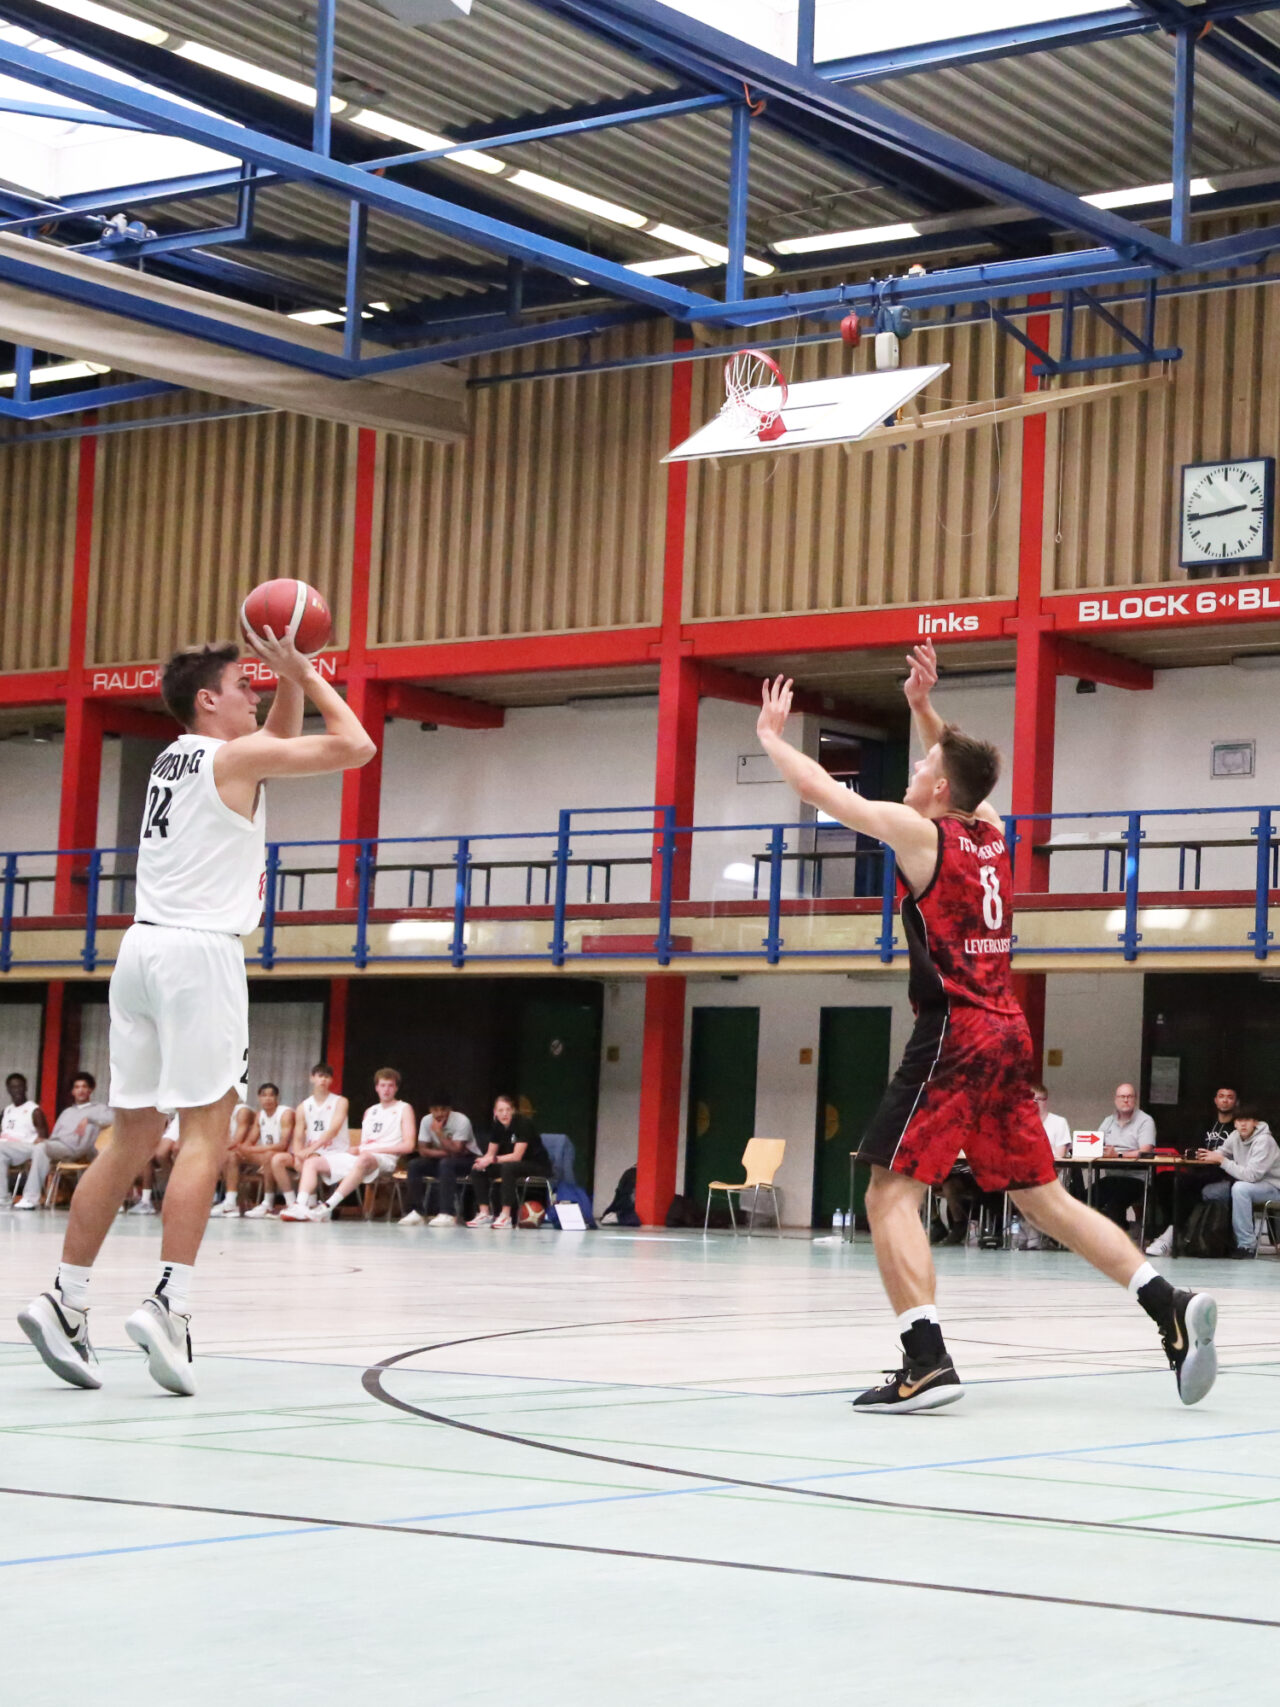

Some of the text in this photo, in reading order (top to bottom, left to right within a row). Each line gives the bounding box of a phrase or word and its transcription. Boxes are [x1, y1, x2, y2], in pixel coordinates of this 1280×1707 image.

[1078, 594, 1190, 622] BLOCK
[1196, 591, 1217, 613] 6
[918, 611, 979, 634] links
[980, 865, 1003, 930] 8
